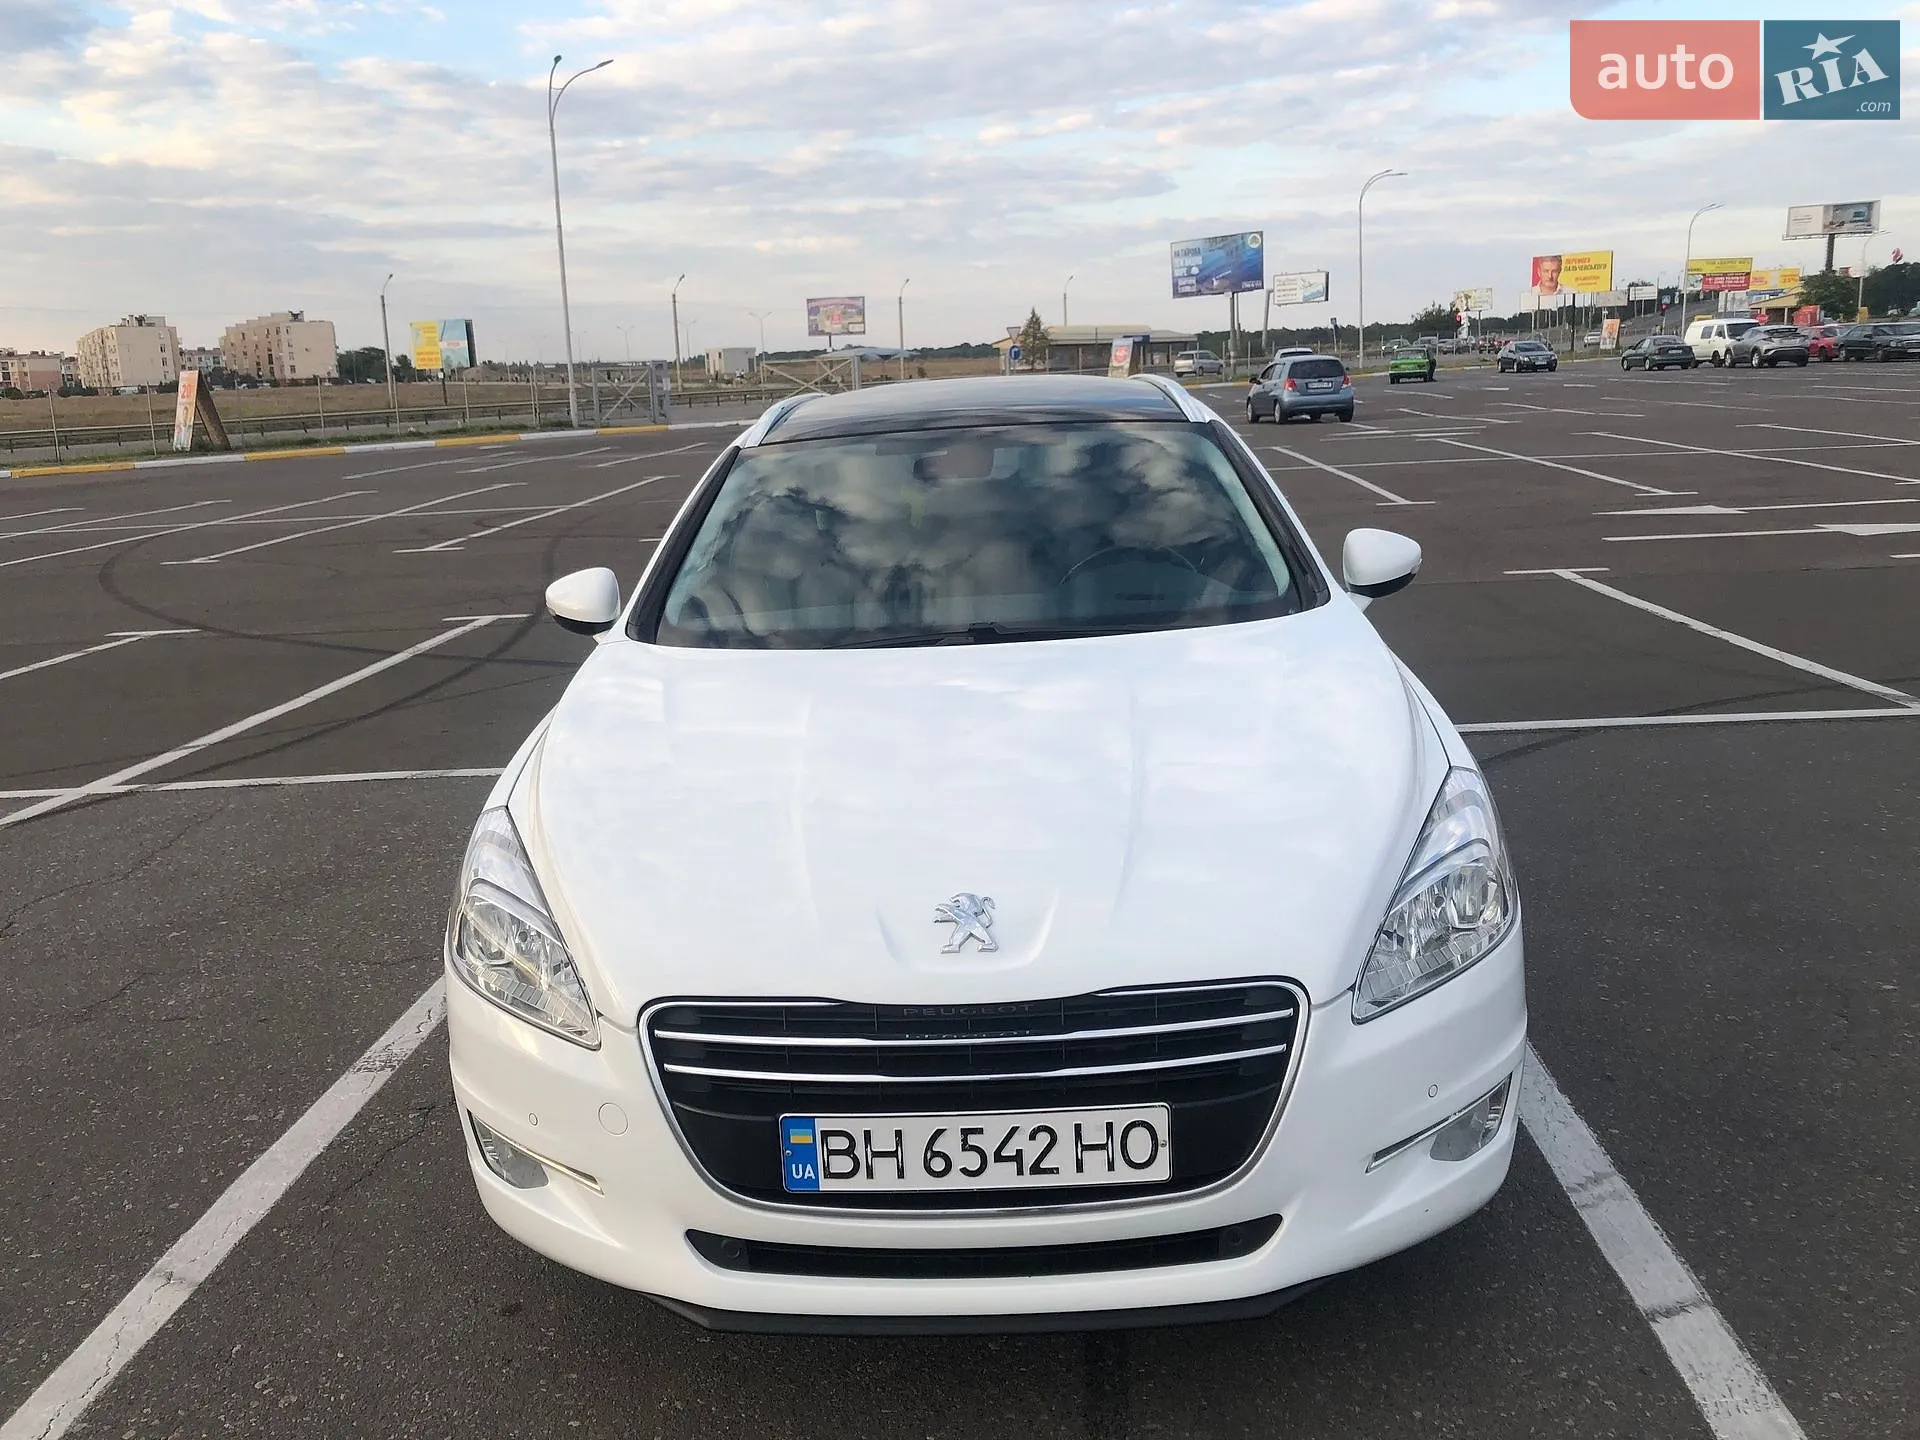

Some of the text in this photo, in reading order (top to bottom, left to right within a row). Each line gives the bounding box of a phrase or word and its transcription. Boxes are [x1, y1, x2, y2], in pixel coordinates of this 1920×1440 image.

[903, 1003, 1036, 1016] PEUGEOT
[819, 1119, 1160, 1180] BH 6542 HO
[791, 1163, 816, 1180] UA
